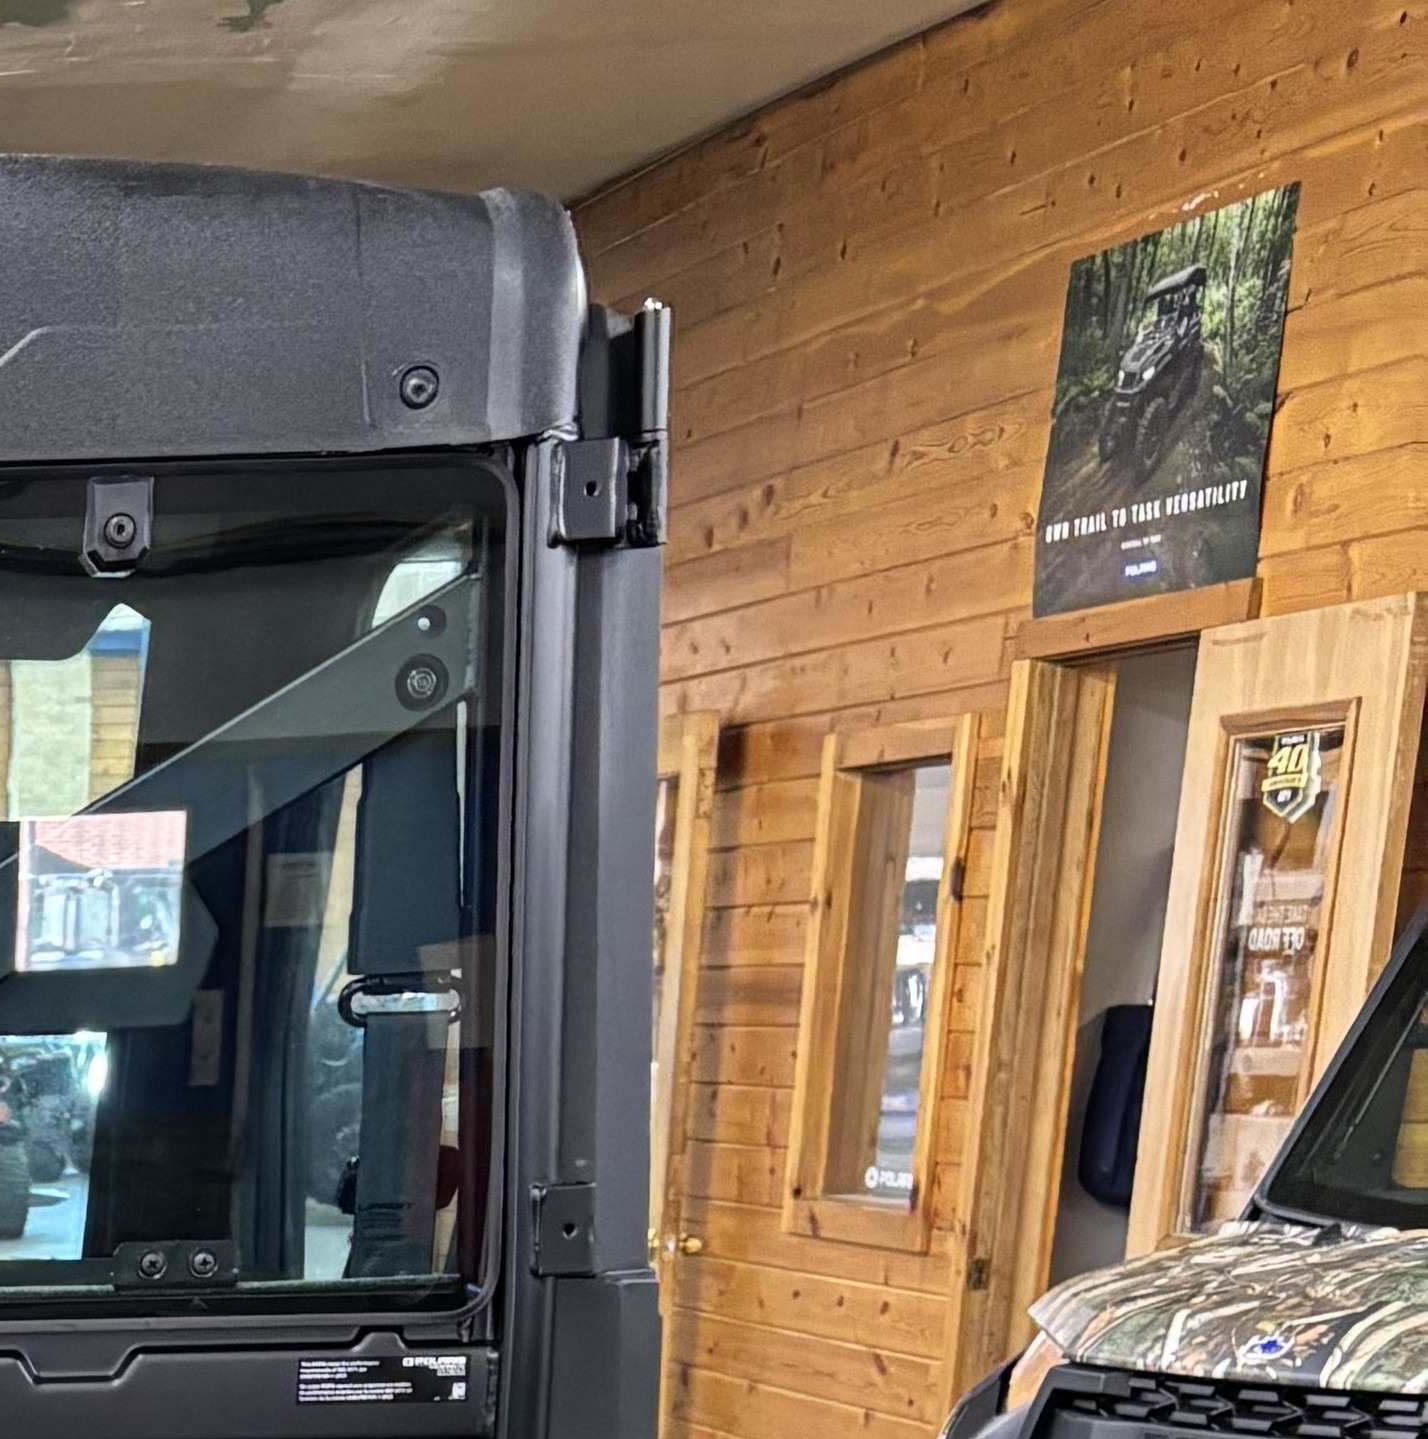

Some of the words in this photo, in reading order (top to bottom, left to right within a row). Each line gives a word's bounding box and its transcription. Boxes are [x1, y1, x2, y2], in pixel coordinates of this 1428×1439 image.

[1073, 511, 1108, 538] TRAIL
[1111, 506, 1127, 529] TO
[1131, 499, 1162, 525] TASK
[1165, 479, 1248, 517] VERSATILITY
[1266, 743, 1309, 775] 40
